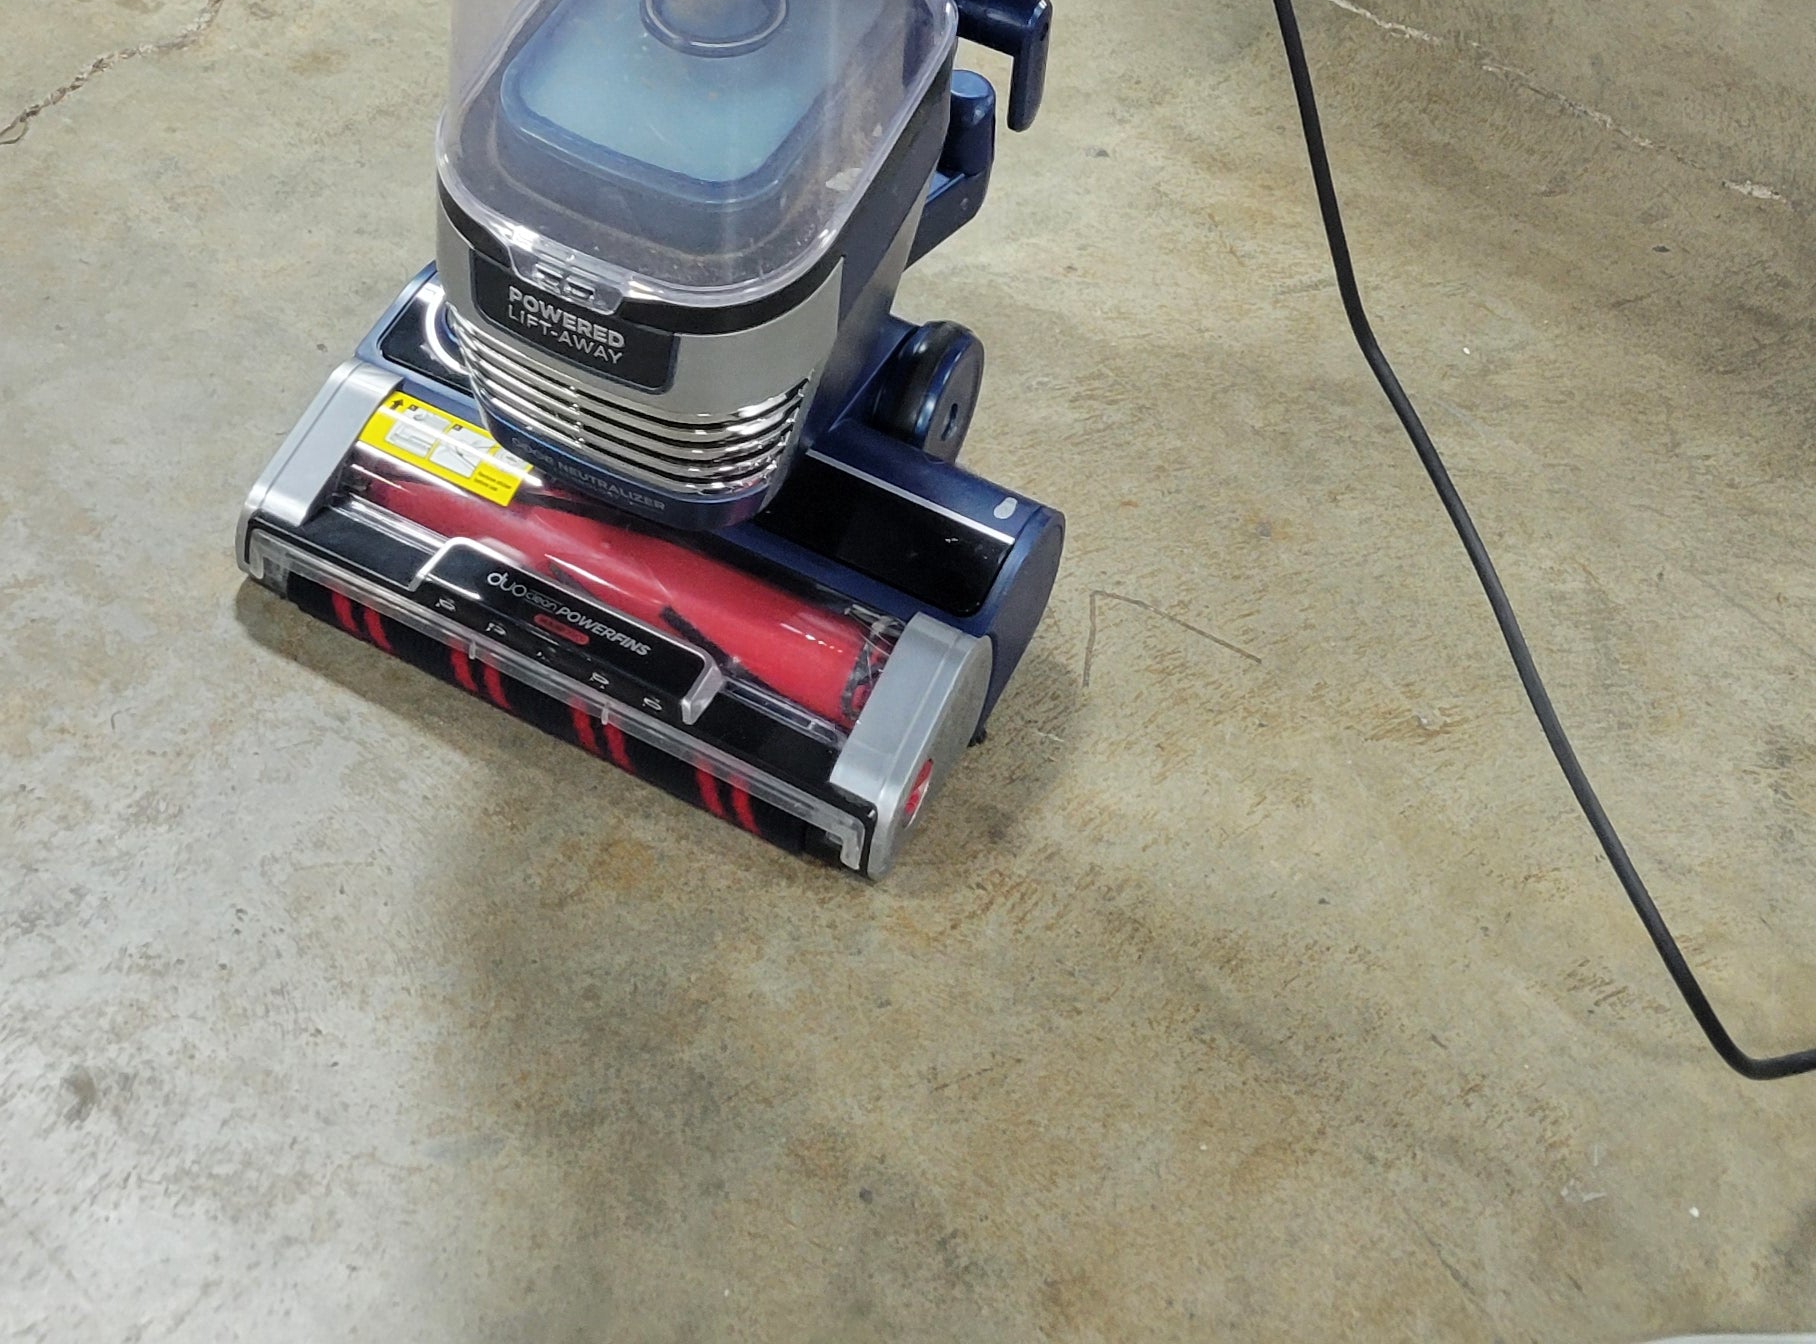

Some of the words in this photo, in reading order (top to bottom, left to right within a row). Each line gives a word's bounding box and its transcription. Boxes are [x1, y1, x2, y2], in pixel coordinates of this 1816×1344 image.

[507, 304, 623, 365] LIFT-AWAY
[508, 285, 626, 348] POWERED
[556, 460, 666, 511] NEUTRALIZER
[555, 605, 652, 657] POWERFINS
